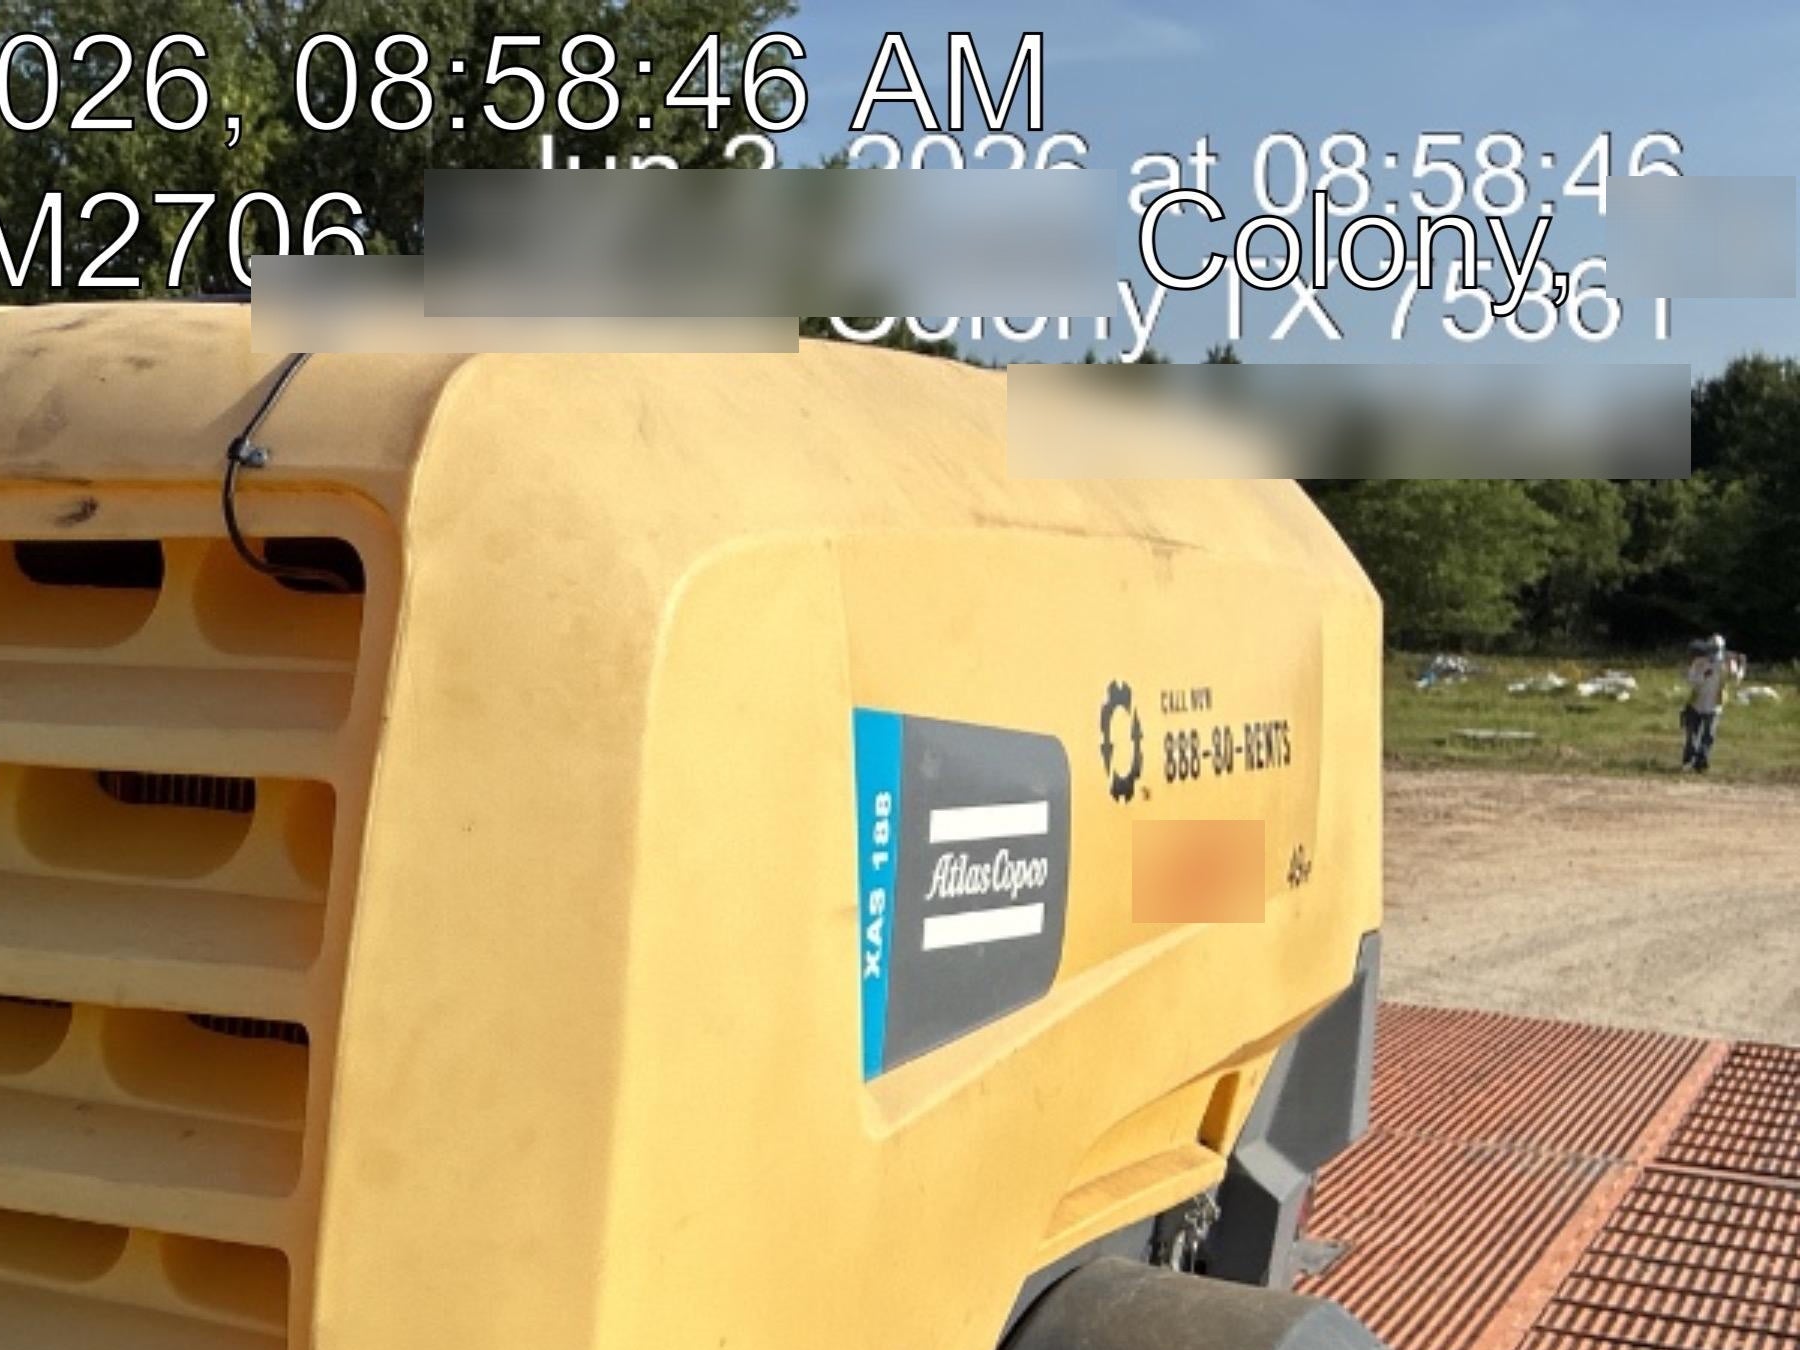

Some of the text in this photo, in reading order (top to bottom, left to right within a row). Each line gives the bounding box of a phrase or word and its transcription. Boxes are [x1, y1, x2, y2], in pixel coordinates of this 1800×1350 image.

[1163, 719, 1291, 784] 888-80-RENTS
[863, 791, 892, 979] XAS 188
[925, 848, 1048, 900] Atlas Copco
